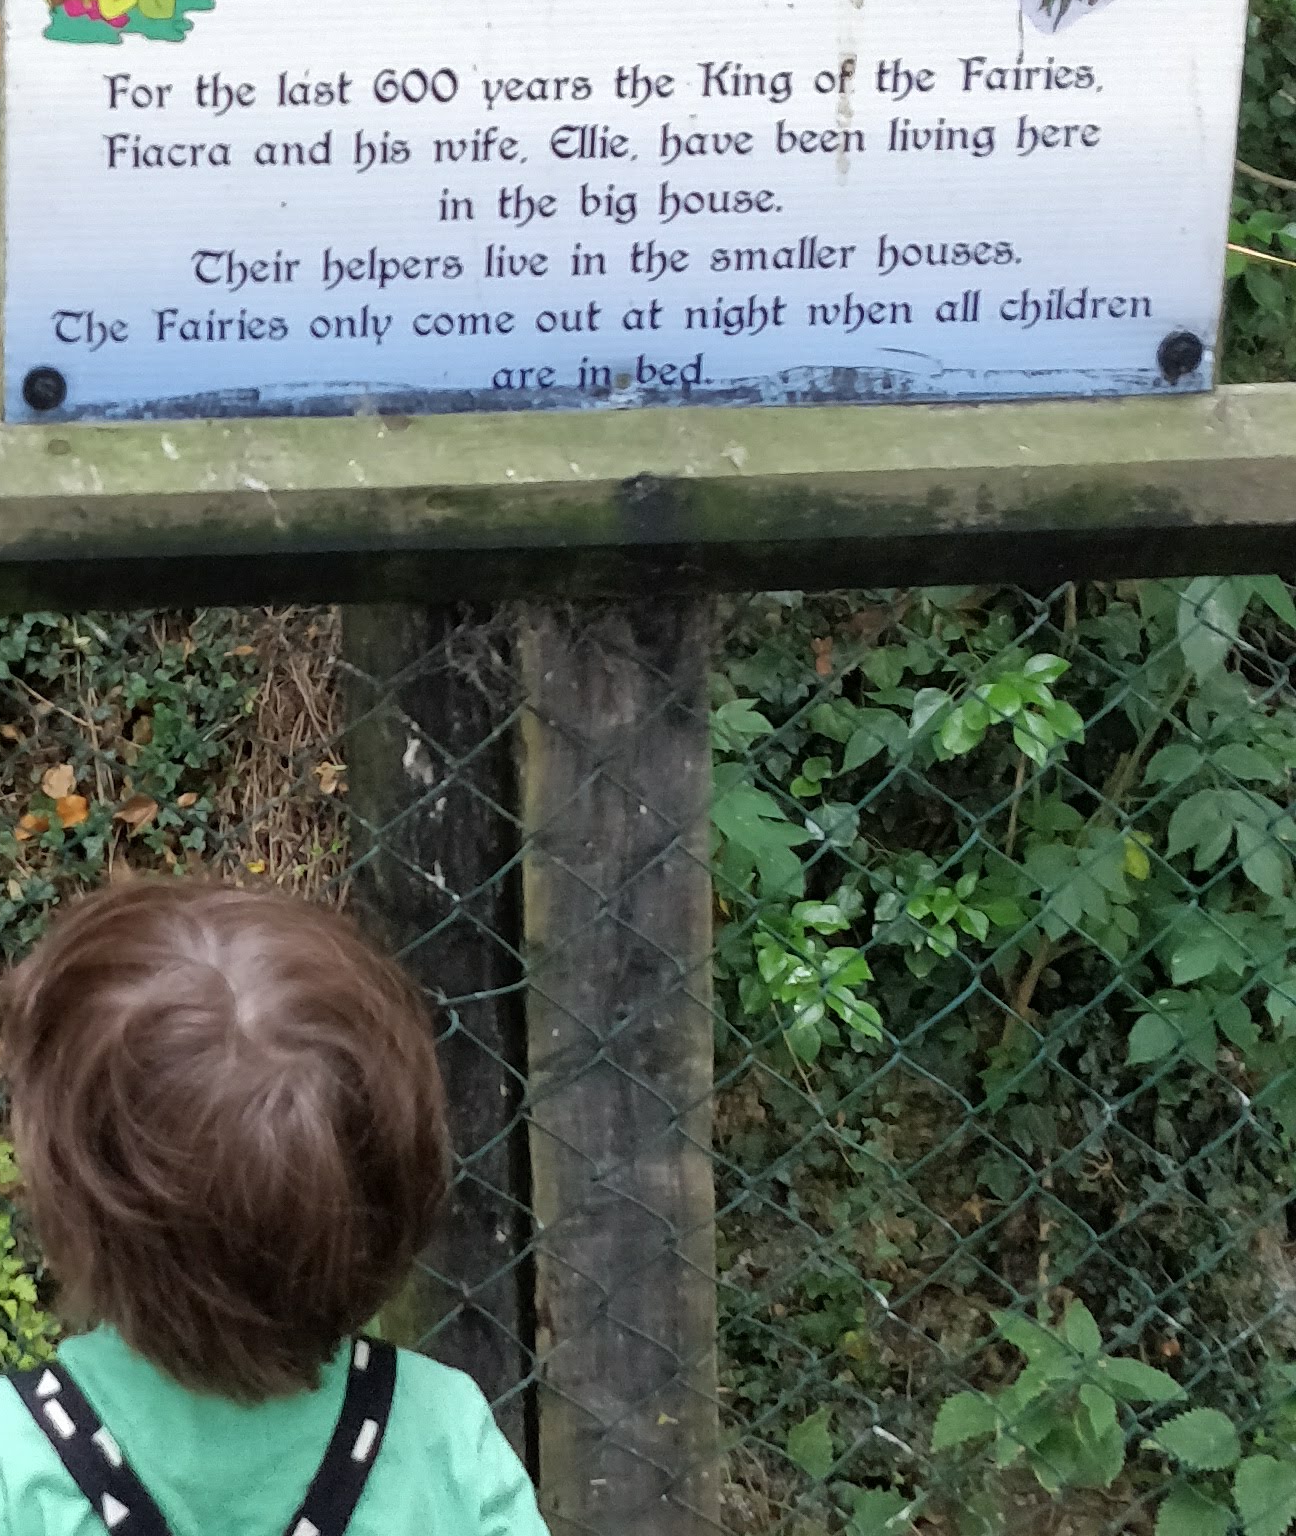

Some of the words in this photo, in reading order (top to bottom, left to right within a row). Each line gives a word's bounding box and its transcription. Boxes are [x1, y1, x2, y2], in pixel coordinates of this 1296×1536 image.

[102, 72, 175, 111] For
[195, 72, 257, 117] the
[277, 69, 353, 108] last
[372, 66, 460, 106] 600
[481, 75, 594, 112] years
[613, 63, 676, 109] the
[697, 60, 794, 104] King
[814, 54, 858, 96] of
[874, 56, 937, 103] the
[102, 132, 233, 170] Fiacra
[254, 128, 333, 167] and
[352, 128, 412, 175] his
[659, 121, 755, 166] have
[775, 117, 866, 156] been
[886, 116, 997, 159] living
[1014, 113, 1103, 158] here
[437, 186, 476, 222] in
[497, 183, 559, 229] the
[580, 181, 639, 225] big
[657, 180, 784, 226] house.
[189, 248, 302, 293] Their
[321, 245, 465, 291] helpers
[484, 243, 550, 279] live
[570, 241, 608, 277] in
[630, 238, 691, 283] the
[709, 234, 858, 273] smaller
[876, 232, 1023, 277] houses.
[49, 307, 130, 355] The
[154, 306, 290, 344] Fairies
[308, 303, 394, 347] only
[411, 309, 517, 338] come
[534, 299, 603, 334] out
[621, 296, 664, 332] at
[684, 293, 789, 338] night
[807, 291, 914, 336] when
[934, 288, 982, 324] all
[998, 285, 1153, 331] children
[491, 365, 558, 393] are
[578, 356, 615, 394] in
[635, 352, 713, 389] bed.
